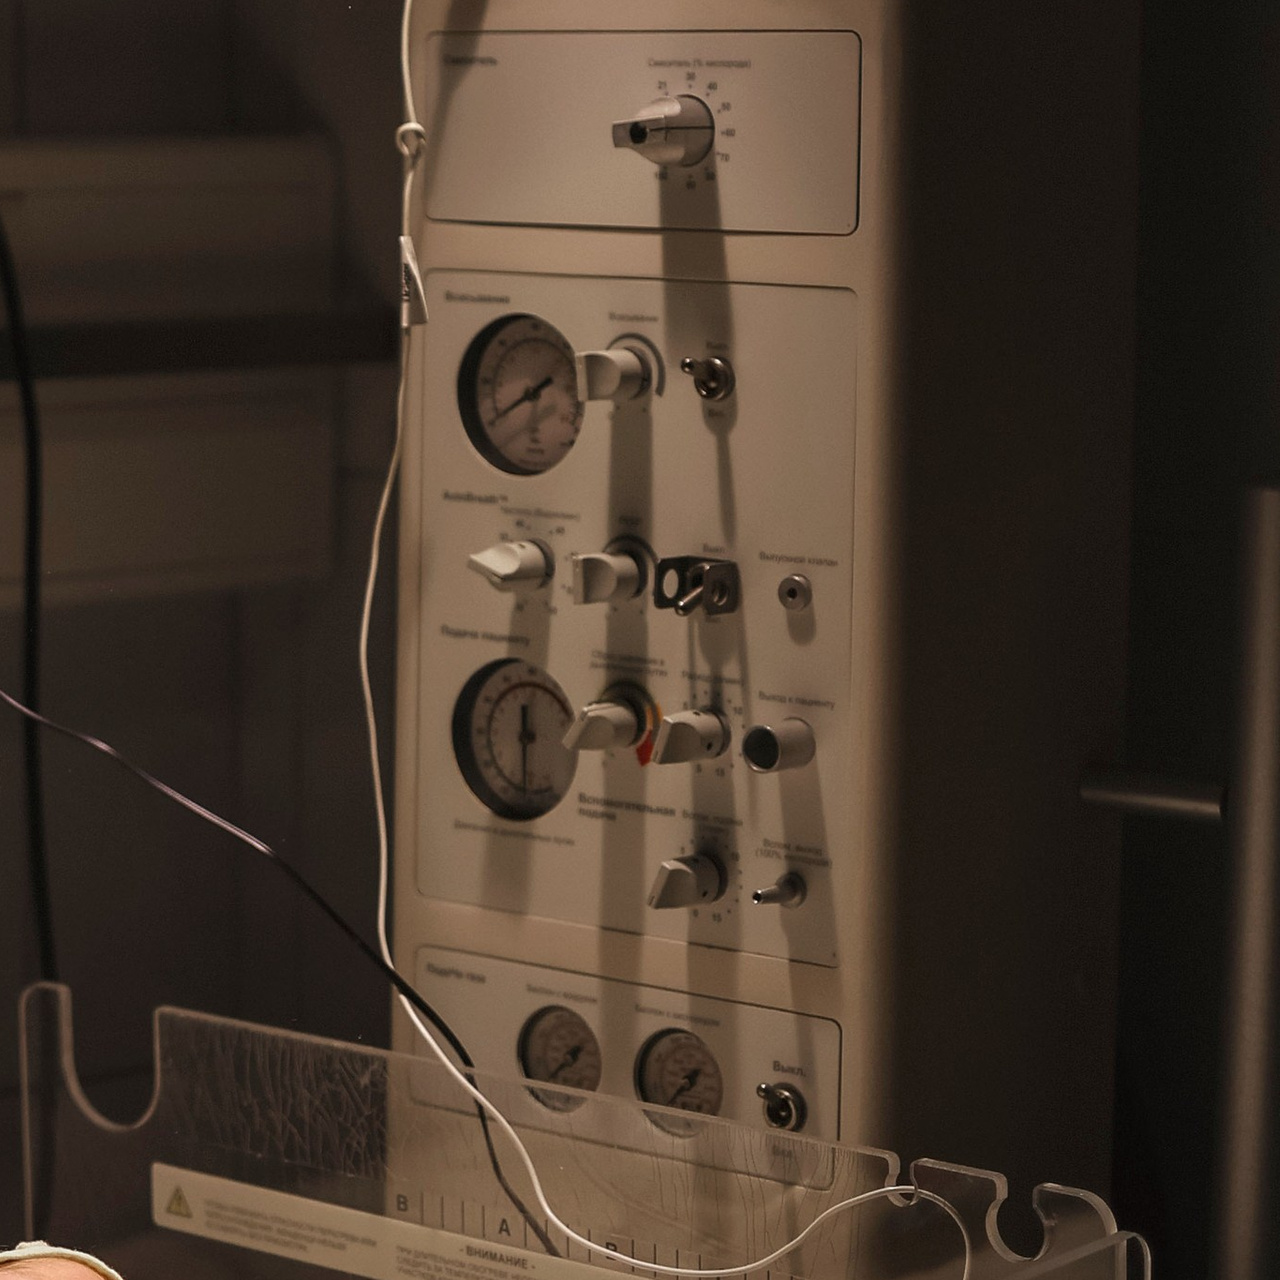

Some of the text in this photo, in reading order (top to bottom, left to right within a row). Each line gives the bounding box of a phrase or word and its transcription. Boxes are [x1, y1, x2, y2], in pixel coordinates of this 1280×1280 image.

[396, 1194, 408, 1212] B
[498, 1218, 511, 1237] A
[465, 1245, 528, 1270] ВНИМАНИЕ
